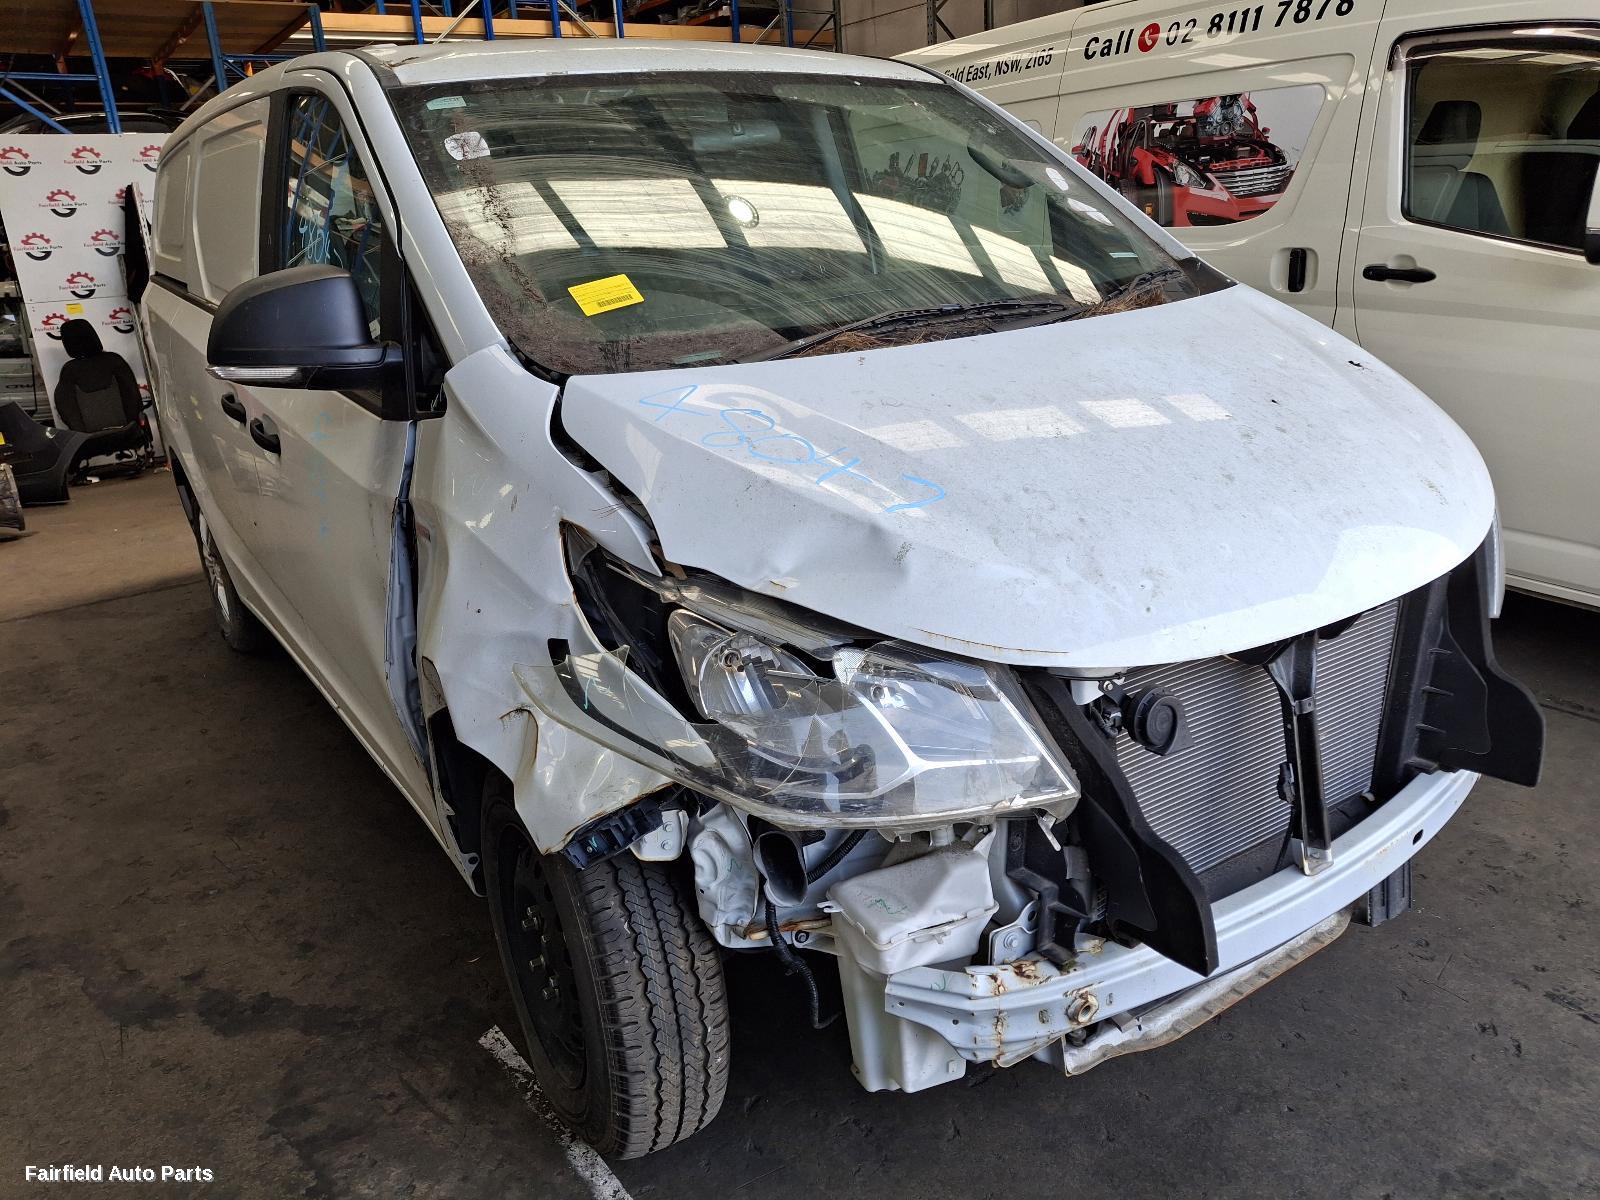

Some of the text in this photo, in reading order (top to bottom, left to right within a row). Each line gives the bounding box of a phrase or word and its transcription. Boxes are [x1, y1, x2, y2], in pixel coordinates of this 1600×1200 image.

[1084, 28, 1134, 60] Call
[1166, 18, 1197, 46] 02
[1206, 5, 1264, 39] 8111
[966, 62, 991, 82] East,
[994, 57, 1022, 76] NSW,
[1025, 47, 1055, 70] 2165
